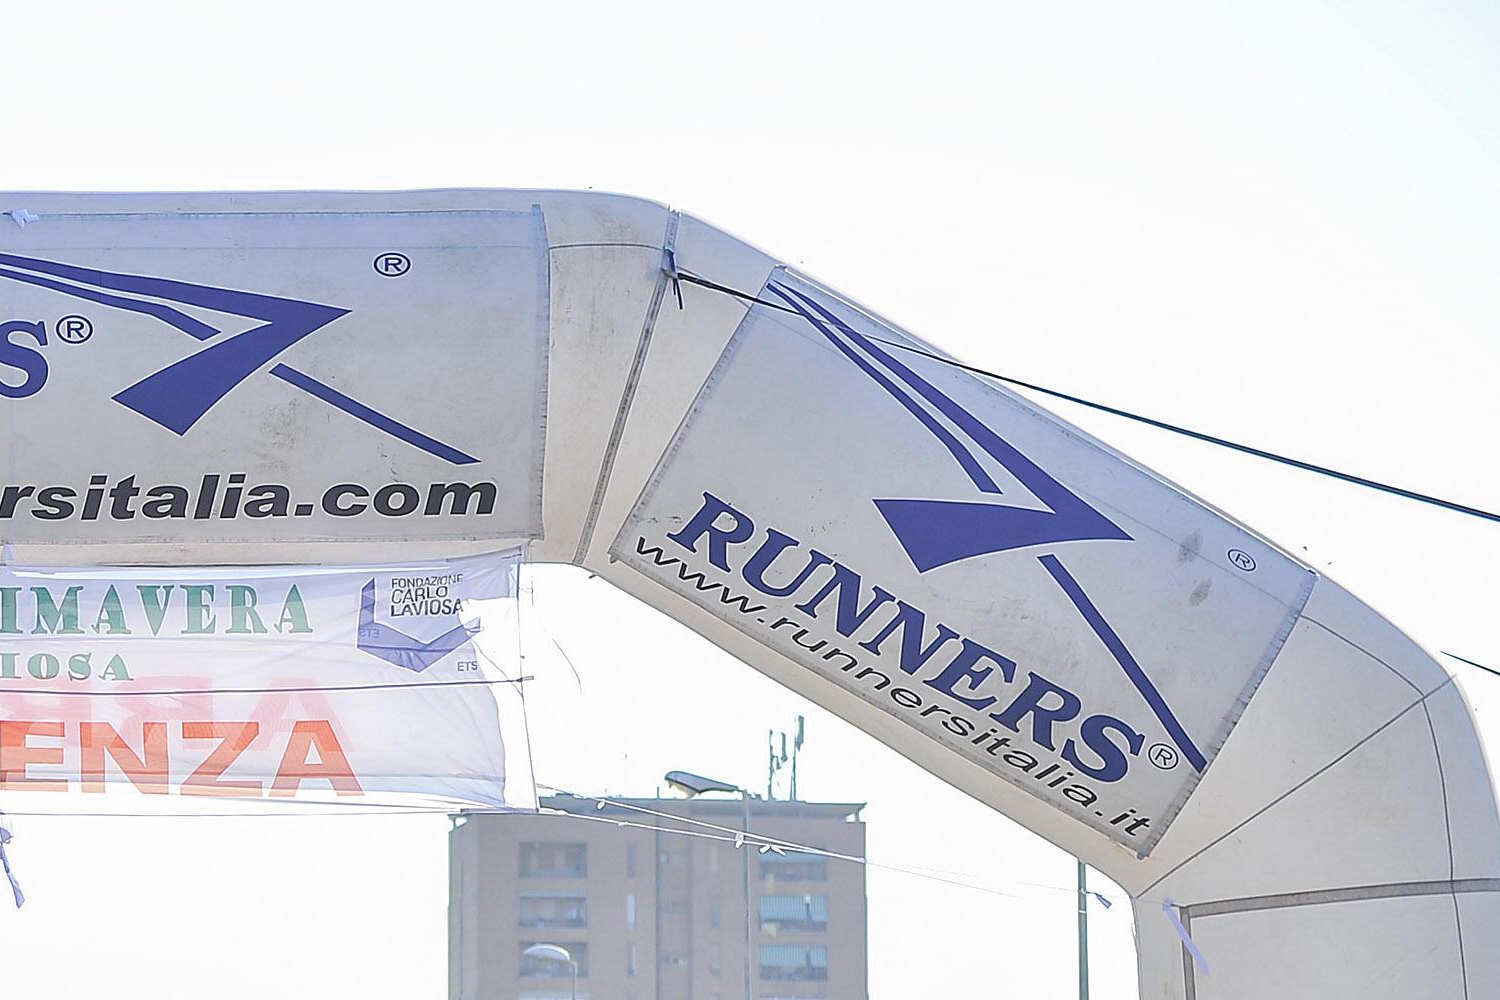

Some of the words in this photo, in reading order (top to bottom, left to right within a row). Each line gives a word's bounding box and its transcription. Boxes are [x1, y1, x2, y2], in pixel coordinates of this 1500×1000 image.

[391, 574, 464, 588] FONDAZIONE
[391, 586, 448, 605] CARLO
[391, 599, 464, 617] LAVIOSA
[457, 661, 478, 671] ETS
[634, 535, 1154, 838] www.runnersitalia.it
